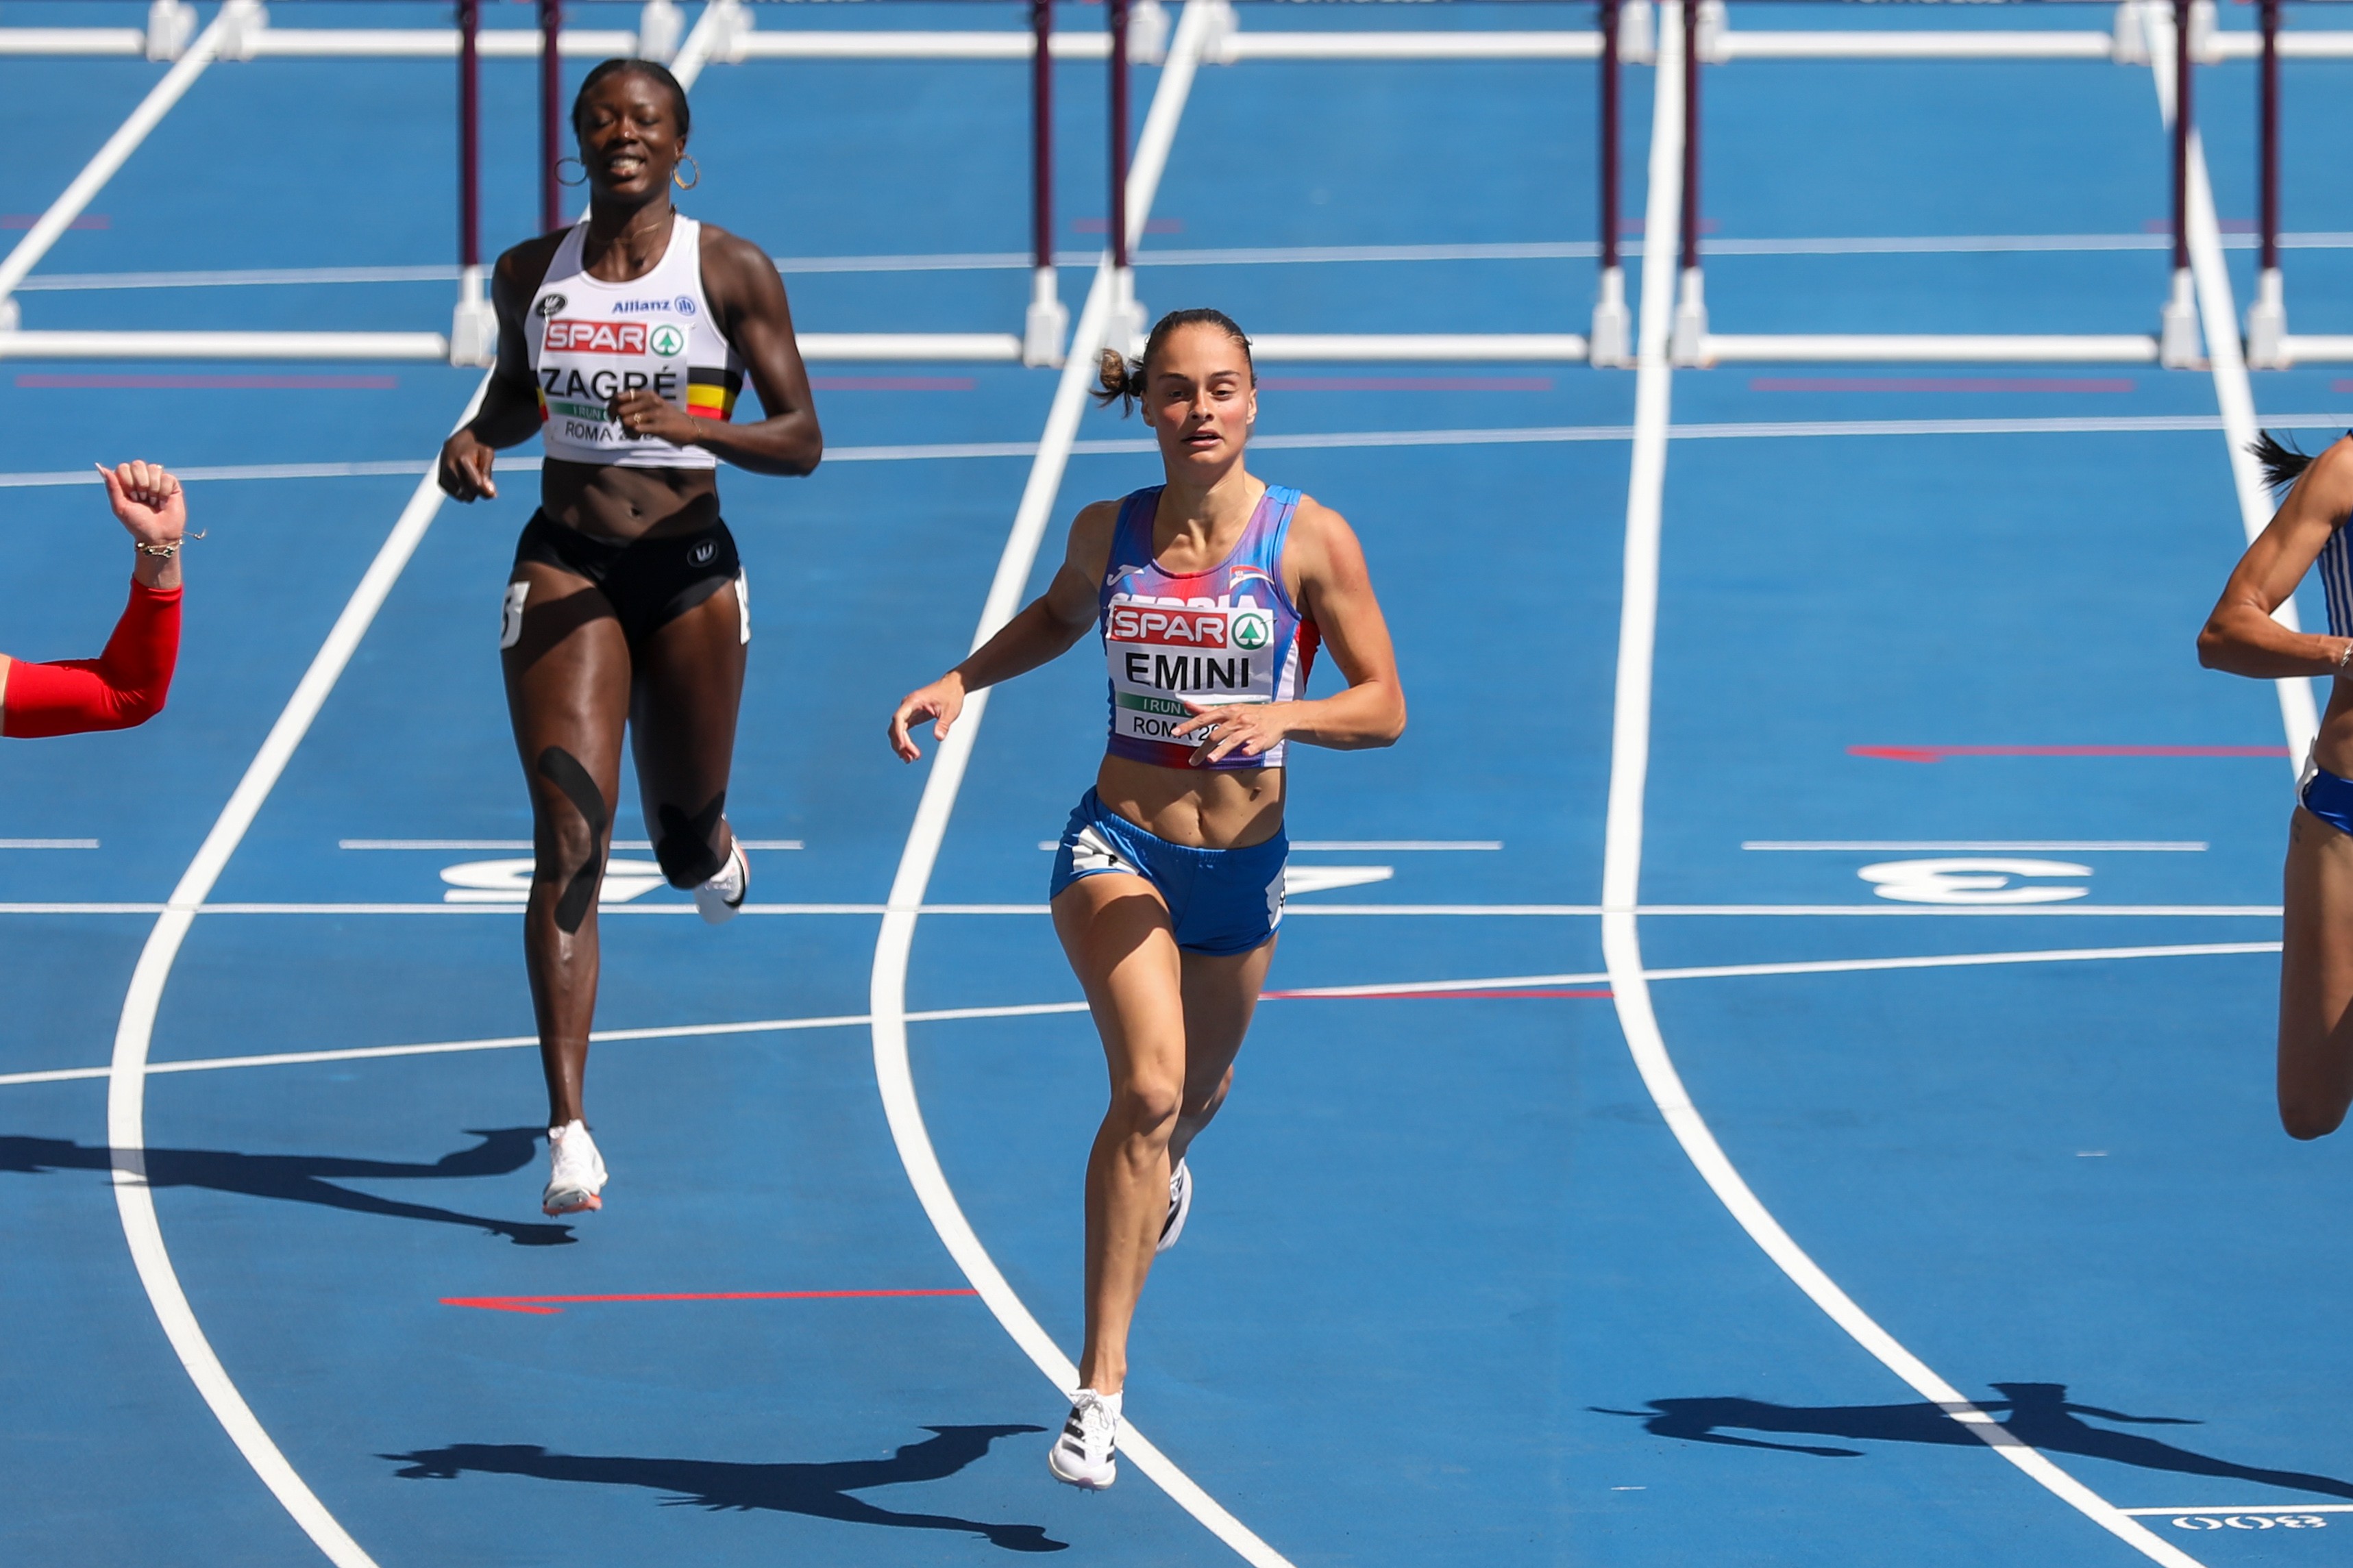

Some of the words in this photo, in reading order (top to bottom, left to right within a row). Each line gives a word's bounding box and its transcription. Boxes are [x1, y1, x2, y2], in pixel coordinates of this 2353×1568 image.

[611, 299, 671, 314] Allianz
[547, 322, 645, 353] SPAR
[578, 406, 600, 420] RUN
[565, 421, 613, 442] ROMA
[1114, 610, 1225, 644] SPAR
[1125, 652, 1250, 692] EMINI
[1150, 699, 1181, 714] RUN
